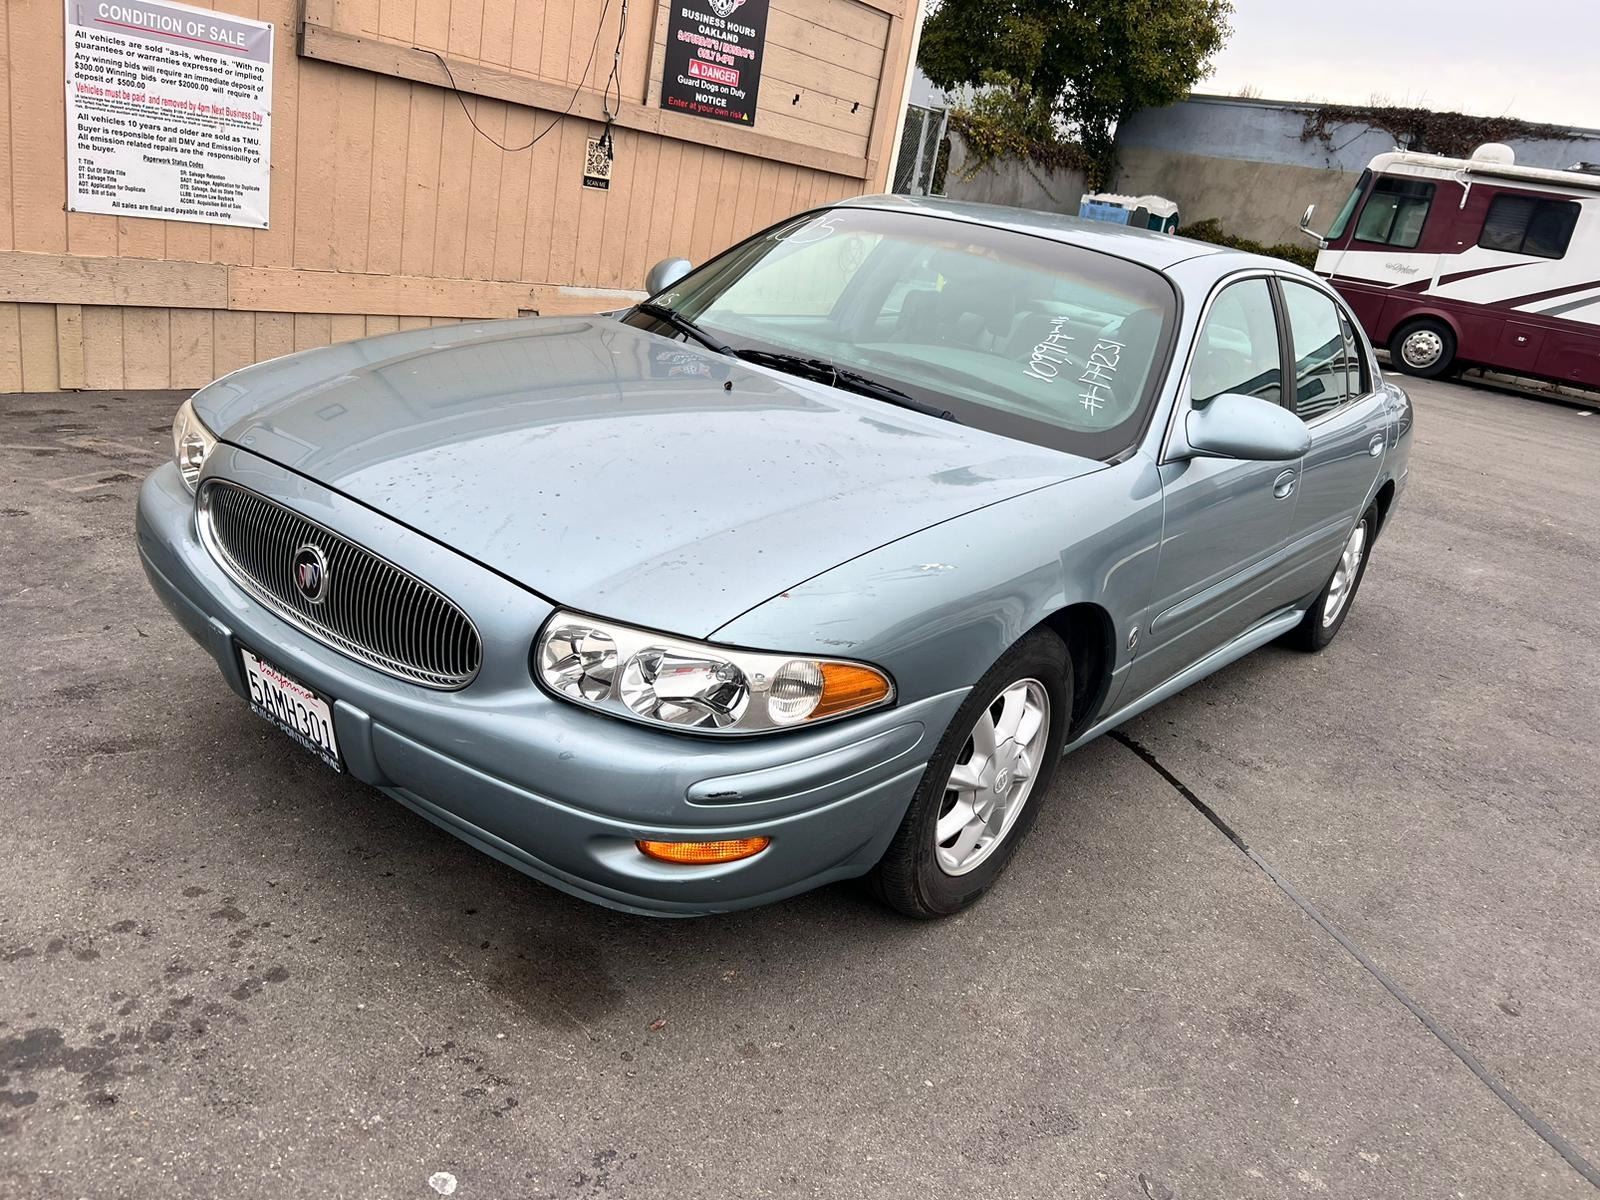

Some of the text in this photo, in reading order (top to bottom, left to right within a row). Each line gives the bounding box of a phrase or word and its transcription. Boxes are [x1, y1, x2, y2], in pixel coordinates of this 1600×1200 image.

[98, 3, 245, 46] CONDITION OF SALE
[682, 8, 755, 37] BUSINESS HOURS
[698, 24, 738, 42] OAKLAND
[74, 30, 86, 39] All
[89, 34, 125, 46] vehicles
[128, 41, 142, 49] are
[144, 45, 162, 53] sold
[193, 54, 217, 64] where
[74, 41, 123, 55] guarantees
[136, 52, 180, 66] warranties
[182, 61, 222, 73] expressed
[74, 52, 90, 62] Any
[91, 56, 122, 68] winning
[124, 60, 140, 70] bids
[156, 68, 182, 77] require
[194, 73, 229, 86] immediate
[230, 81, 255, 91] deposit
[74, 61, 104, 73] $300.00
[105, 66, 137, 80] Winning
[140, 73, 157, 82] bids
[178, 79, 208, 91] $2000.00
[227, 89, 250, 98] require
[74, 71, 103, 82] deposit
[117, 78, 145, 89] $500.00
[701, 65, 735, 82] DANGER
[677, 74, 699, 86] Guard
[701, 80, 718, 92] Dogs
[730, 87, 745, 99] Duty
[695, 92, 726, 106] NOTICE
[75, 81, 103, 96] Vehicles
[104, 89, 121, 99] must
[131, 92, 145, 102] paid
[148, 95, 160, 105] and
[161, 98, 187, 109] removed
[197, 102, 210, 113] 4pm
[211, 104, 224, 116] Next
[225, 106, 251, 120] Business
[252, 111, 262, 122] Day
[668, 96, 687, 107] Enter
[697, 104, 713, 112] your
[77, 112, 88, 120] All
[91, 115, 125, 126] vehicles
[128, 119, 137, 127] 10
[138, 123, 161, 131] years
[179, 128, 199, 136] older
[77, 123, 100, 133] Buyer
[111, 129, 154, 140] responsible
[156, 134, 166, 142] for
[178, 137, 195, 146] DMV
[211, 142, 242, 152] Emission
[77, 142, 90, 150] the
[77, 132, 88, 140] All
[90, 135, 124, 145] emission
[126, 140, 152, 149] related
[153, 144, 178, 152] repairs
[192, 148, 203, 156] the
[207, 151, 251, 163] responsibility
[142, 154, 203, 169] Paperwork Status Codes
[259, 659, 318, 708] California
[248, 669, 335, 757] 5AMH301
